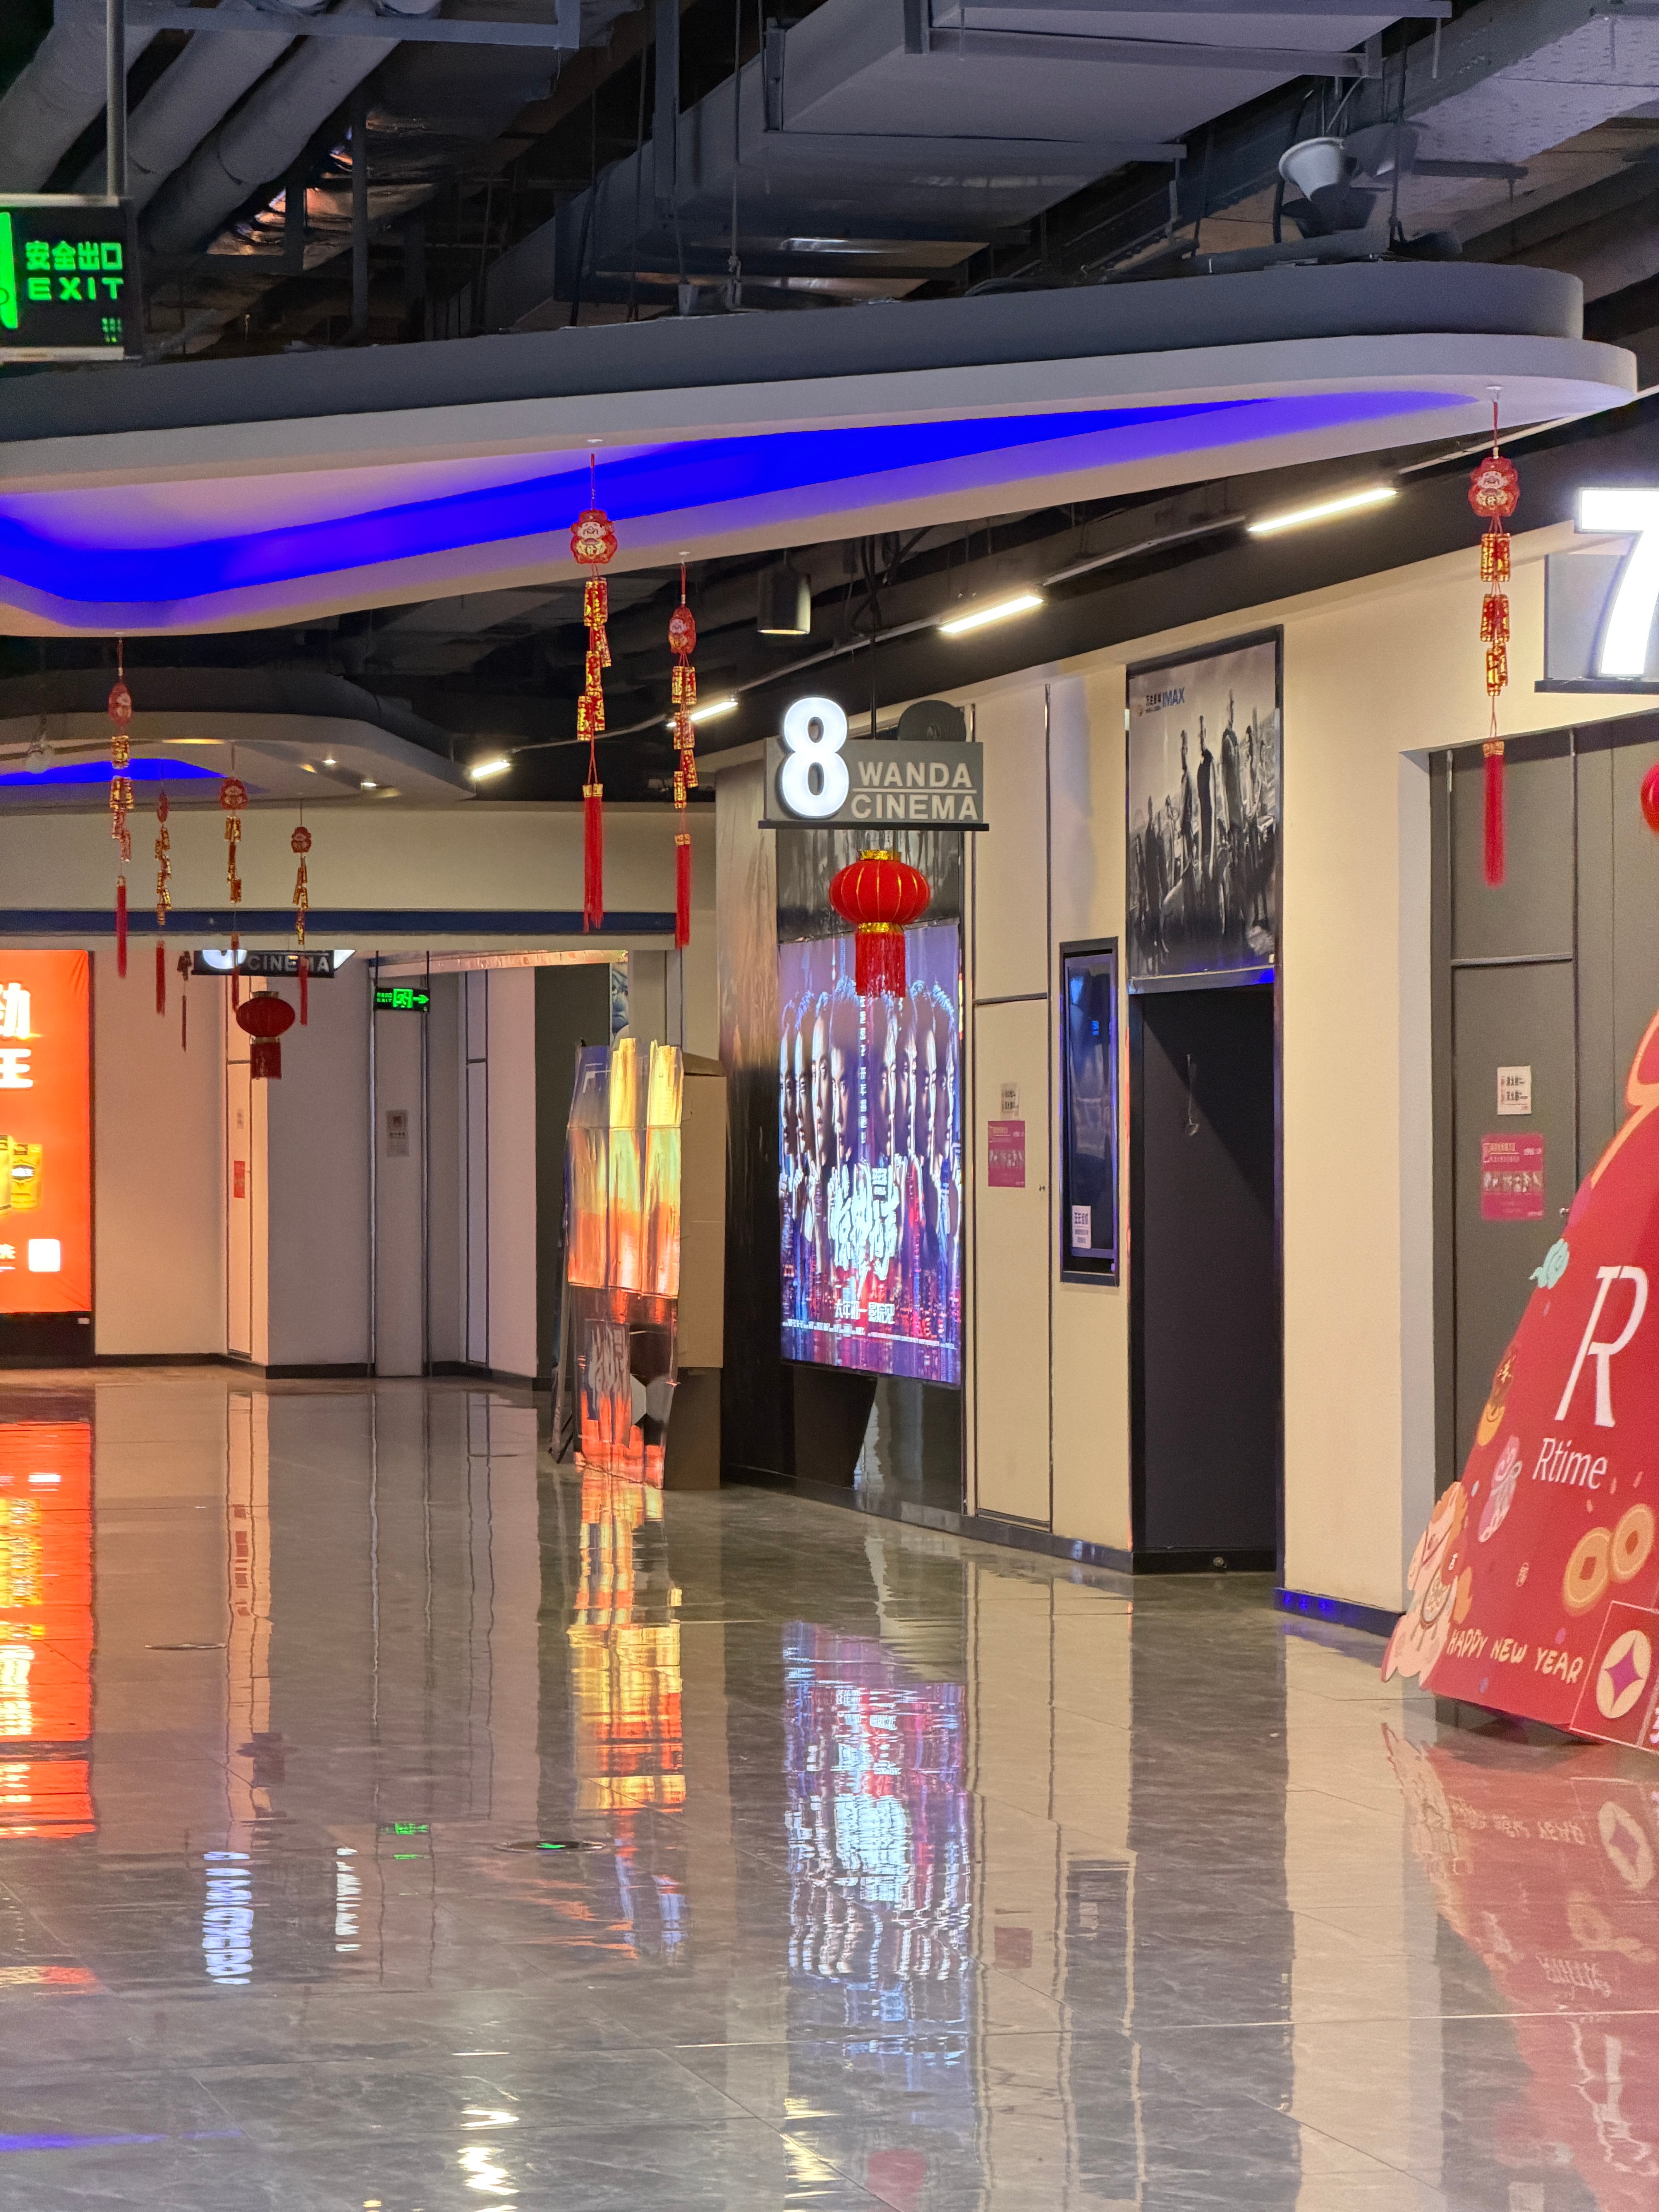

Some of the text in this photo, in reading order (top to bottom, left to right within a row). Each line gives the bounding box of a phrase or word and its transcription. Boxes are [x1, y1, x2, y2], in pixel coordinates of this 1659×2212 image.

[26, 240, 123, 271] 安全出口
[27, 277, 124, 301] EXIT
[1582, 490, 1659, 675] 7
[1162, 687, 1185, 708] IMAX
[782, 697, 849, 817] 8
[857, 761, 973, 788] WANDA
[851, 793, 979, 821] CINEMA
[1532, 1437, 1607, 1489] Rtime
[1446, 1628, 1584, 1685] HAPPY NEW YEAR
